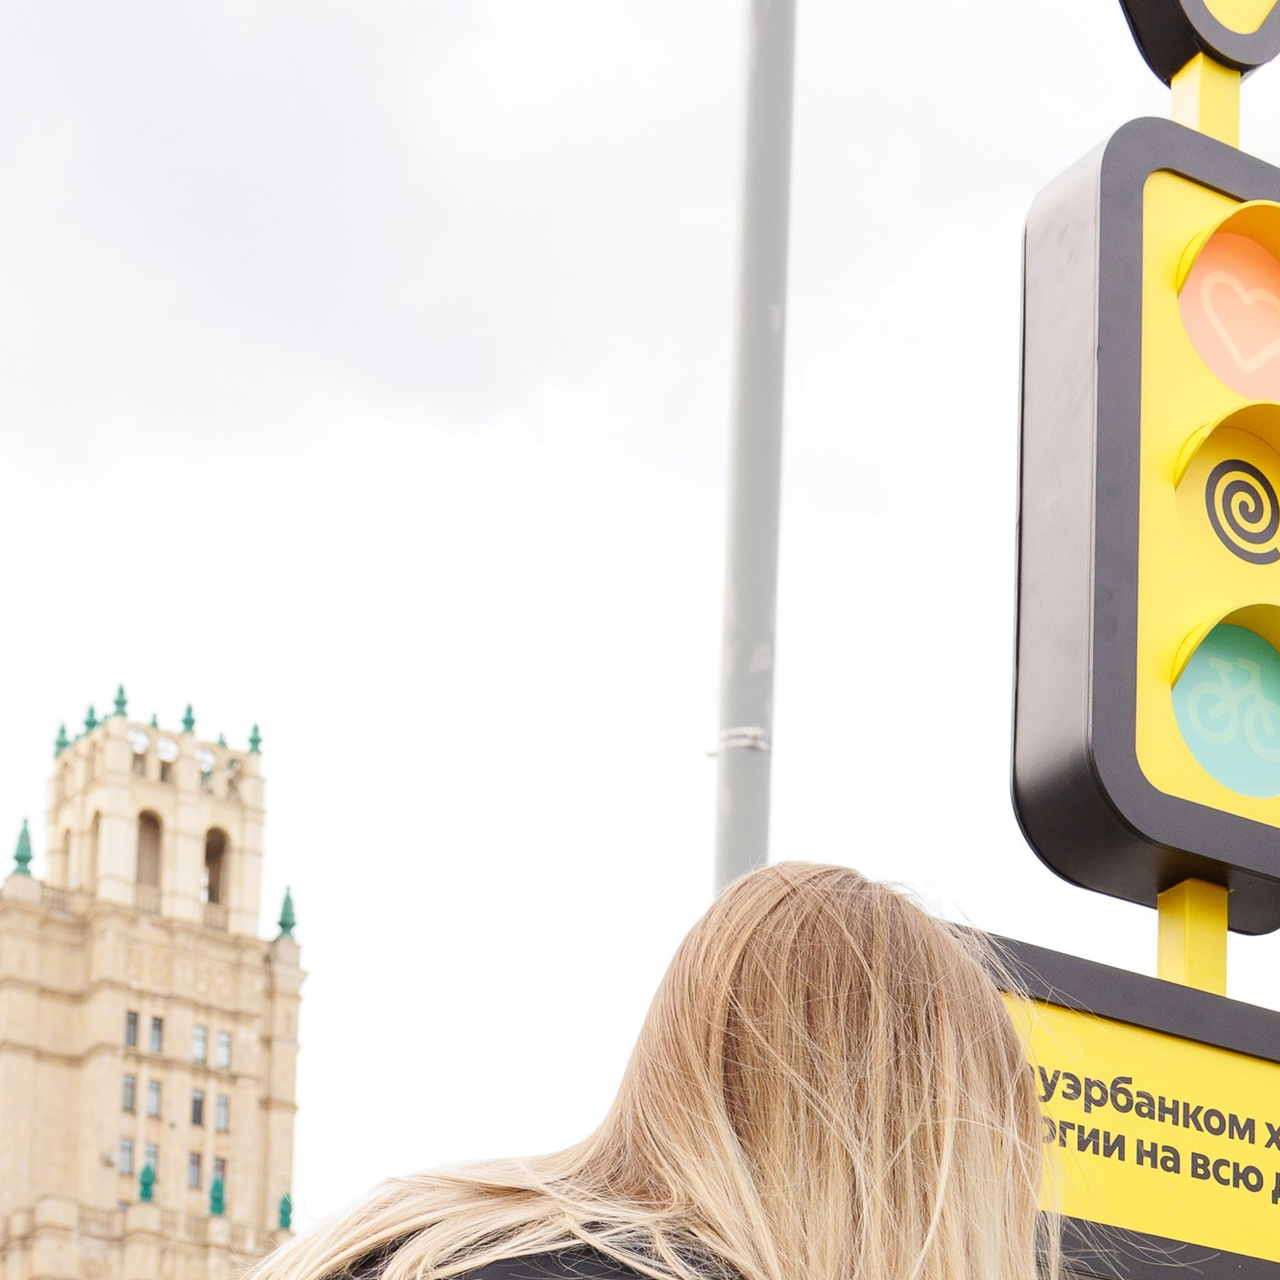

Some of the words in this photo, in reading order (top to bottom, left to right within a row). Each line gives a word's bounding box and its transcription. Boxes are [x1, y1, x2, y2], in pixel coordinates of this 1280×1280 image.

[1028, 1063, 1256, 1144] уэрбанком
[1135, 1139, 1181, 1173] на
[1190, 1152, 1264, 1193] всю
